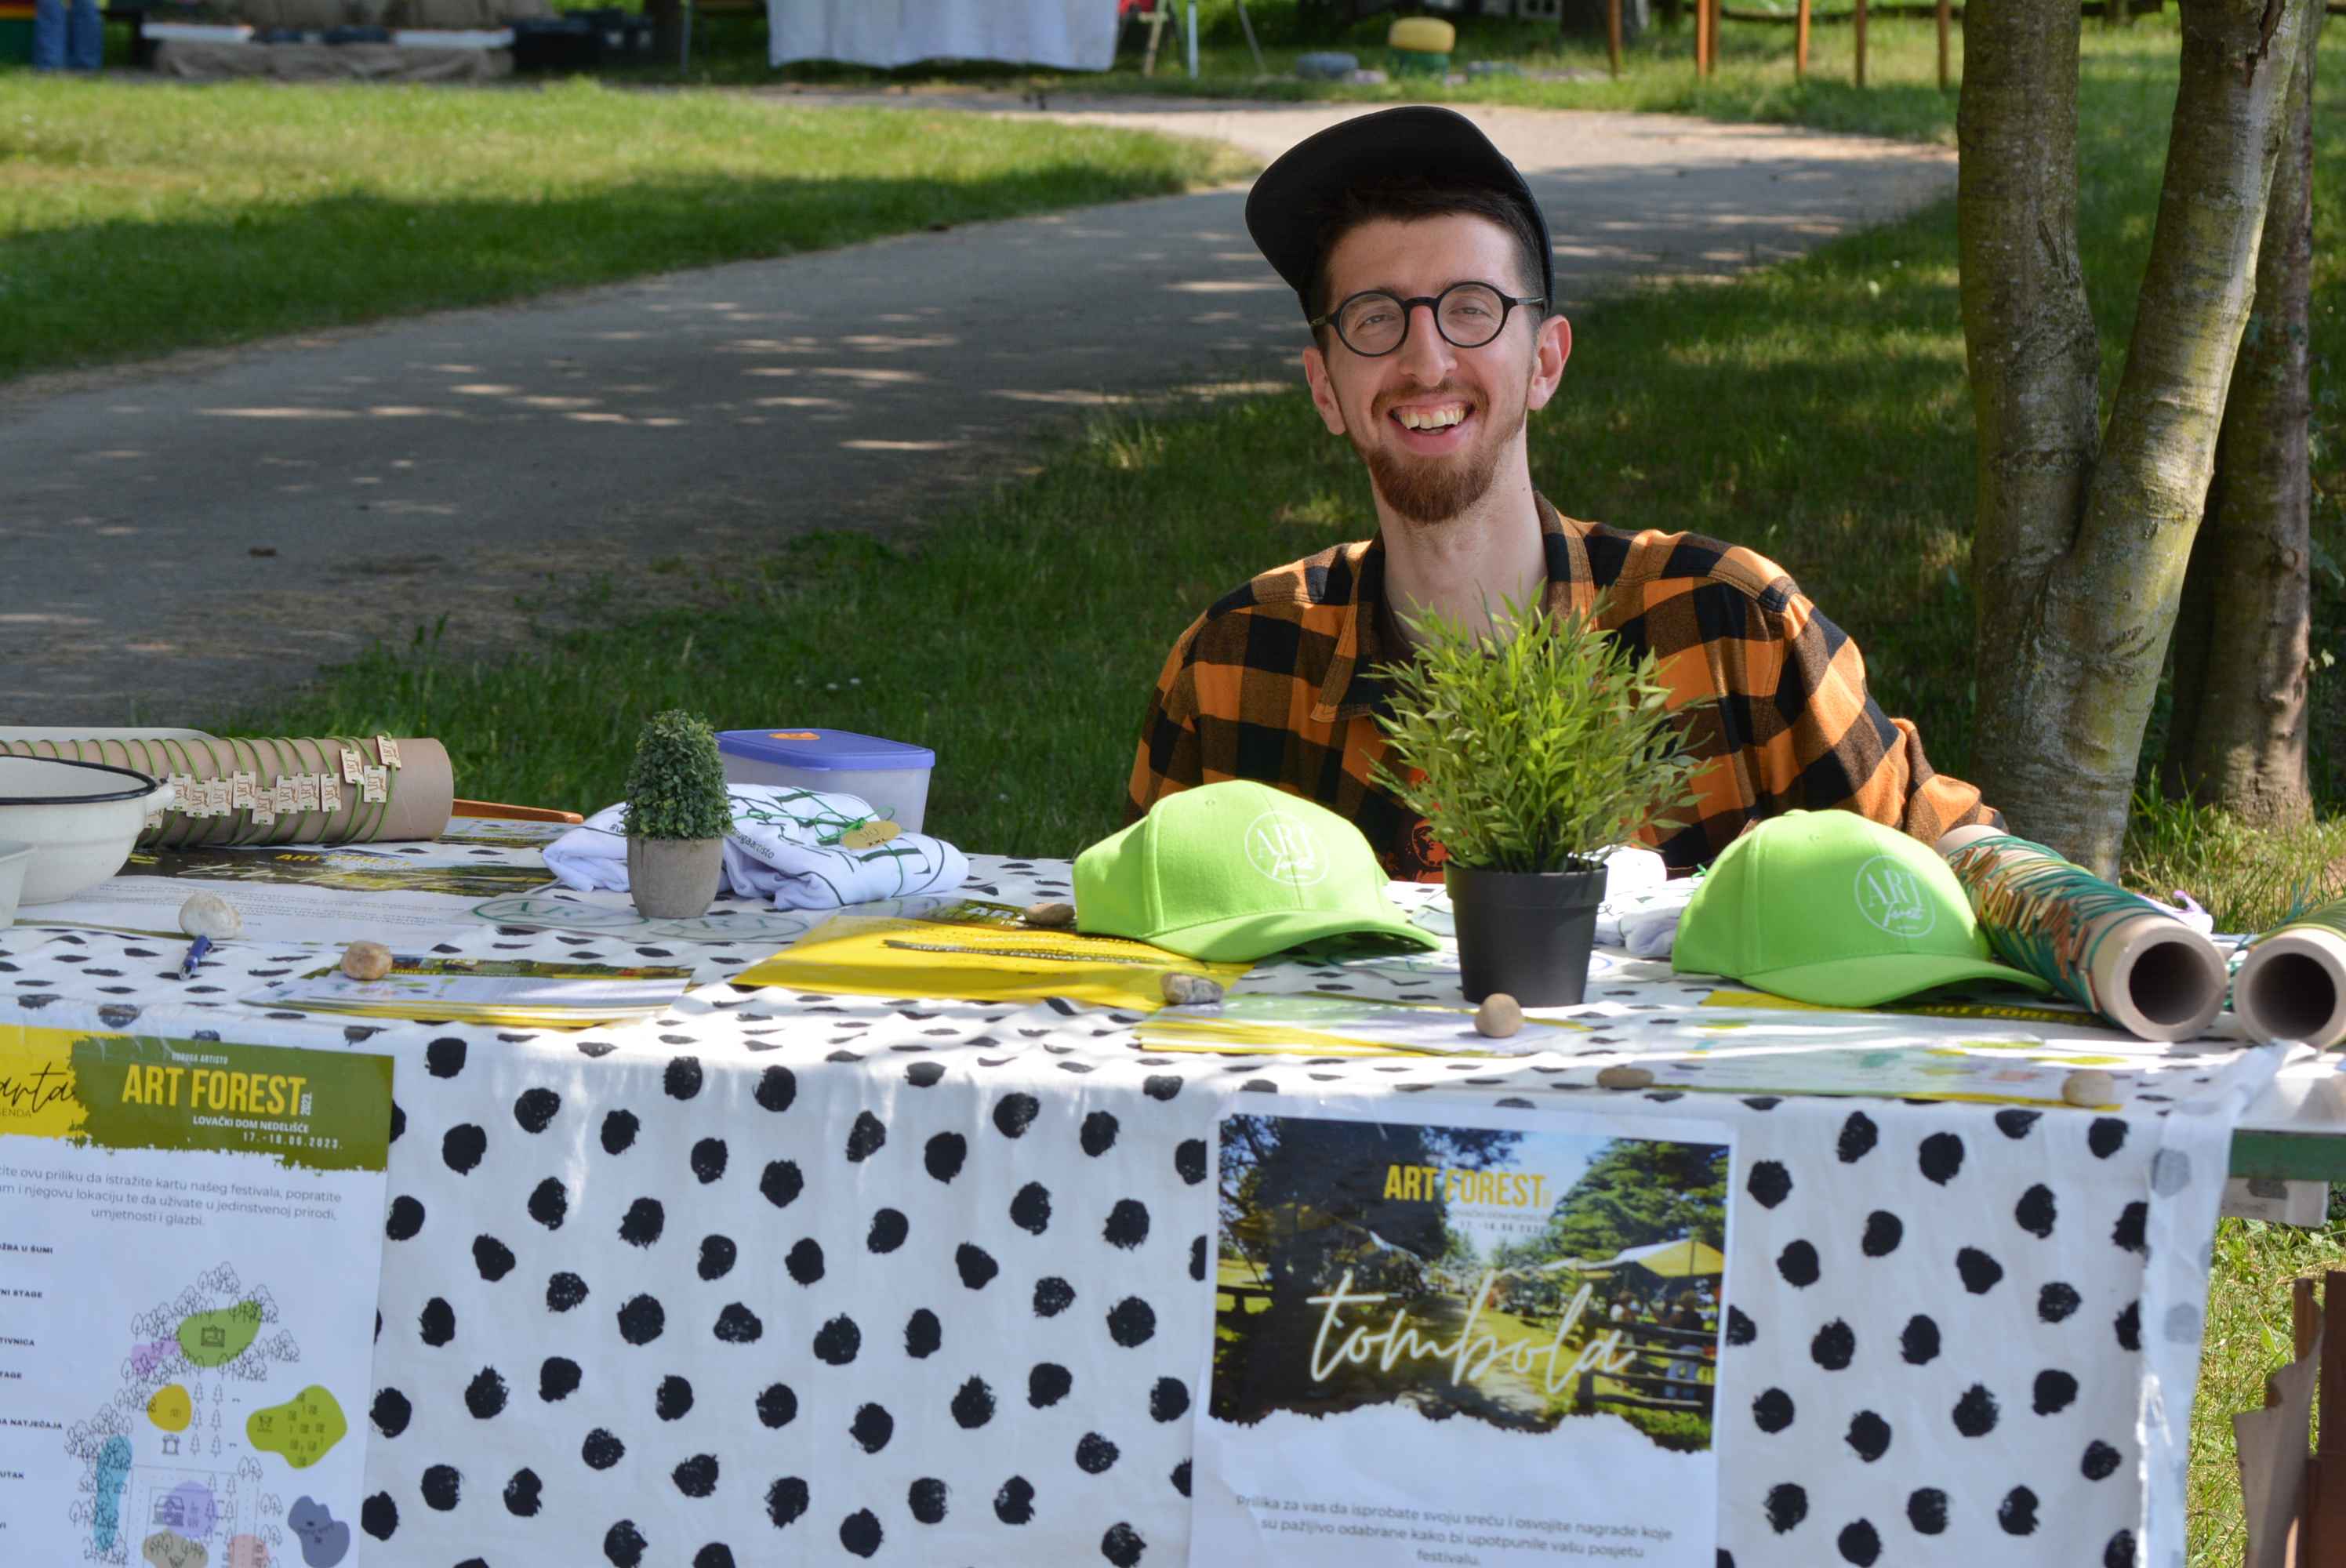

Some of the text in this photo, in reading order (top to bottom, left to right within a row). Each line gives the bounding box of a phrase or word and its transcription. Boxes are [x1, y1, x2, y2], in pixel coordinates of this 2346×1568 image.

[1256, 822, 1314, 861] ART
[1868, 869, 1923, 908] ART
[122, 1064, 307, 1116] ART FOREST
[193, 1115, 234, 1127] LOVAČKI
[235, 1120, 258, 1129] DOM
[20, 1168, 42, 1178] ovu
[45, 1169, 83, 1183] priliku
[86, 1172, 102, 1183] da
[105, 1174, 152, 1187] istražite
[156, 1177, 187, 1191] kartu
[191, 1181, 227, 1196] našeg
[231, 1183, 283, 1199] festivala,
[285, 1189, 342, 1203] popratite
[24, 1185, 73, 1200] njegovu
[76, 1189, 123, 1203] lokaciju
[127, 1194, 139, 1203] te
[141, 1194, 157, 1205] da
[160, 1197, 202, 1210] uživate
[206, 1202, 214, 1210] u
[216, 1201, 291, 1218] jedinstvenoj
[293, 1207, 338, 1221] prirodi,
[1383, 1164, 1439, 1202] ART
[1444, 1169, 1546, 1208] FOREST
[91, 1208, 157, 1222] umjetnosti
[165, 1213, 205, 1227] glazbi.
[13, 1290, 42, 1298] STAGE
[1306, 1269, 1636, 1393] tombola
[10, 1418, 63, 1430] NATJEČAJA
[1262, 1519, 1276, 1529] su
[1280, 1519, 1334, 1534] pažljivo
[1338, 1523, 1406, 1539] odabrane
[1411, 1528, 1445, 1543] kako
[1450, 1530, 1464, 1544] bi
[1467, 1534, 1547, 1551] upotpunile
[1588, 1544, 1644, 1559] posjetu
[1284, 1501, 1299, 1511] za
[1302, 1503, 1326, 1513] vas
[1330, 1501, 1347, 1514] da
[1352, 1502, 1418, 1520] isprobate
[1423, 1511, 1460, 1526] svoju
[1464, 1513, 1504, 1526] sreću
[1515, 1516, 1571, 1534] osvojite
[1575, 1523, 1636, 1537] nagrade
[1641, 1526, 1672, 1542] koje
